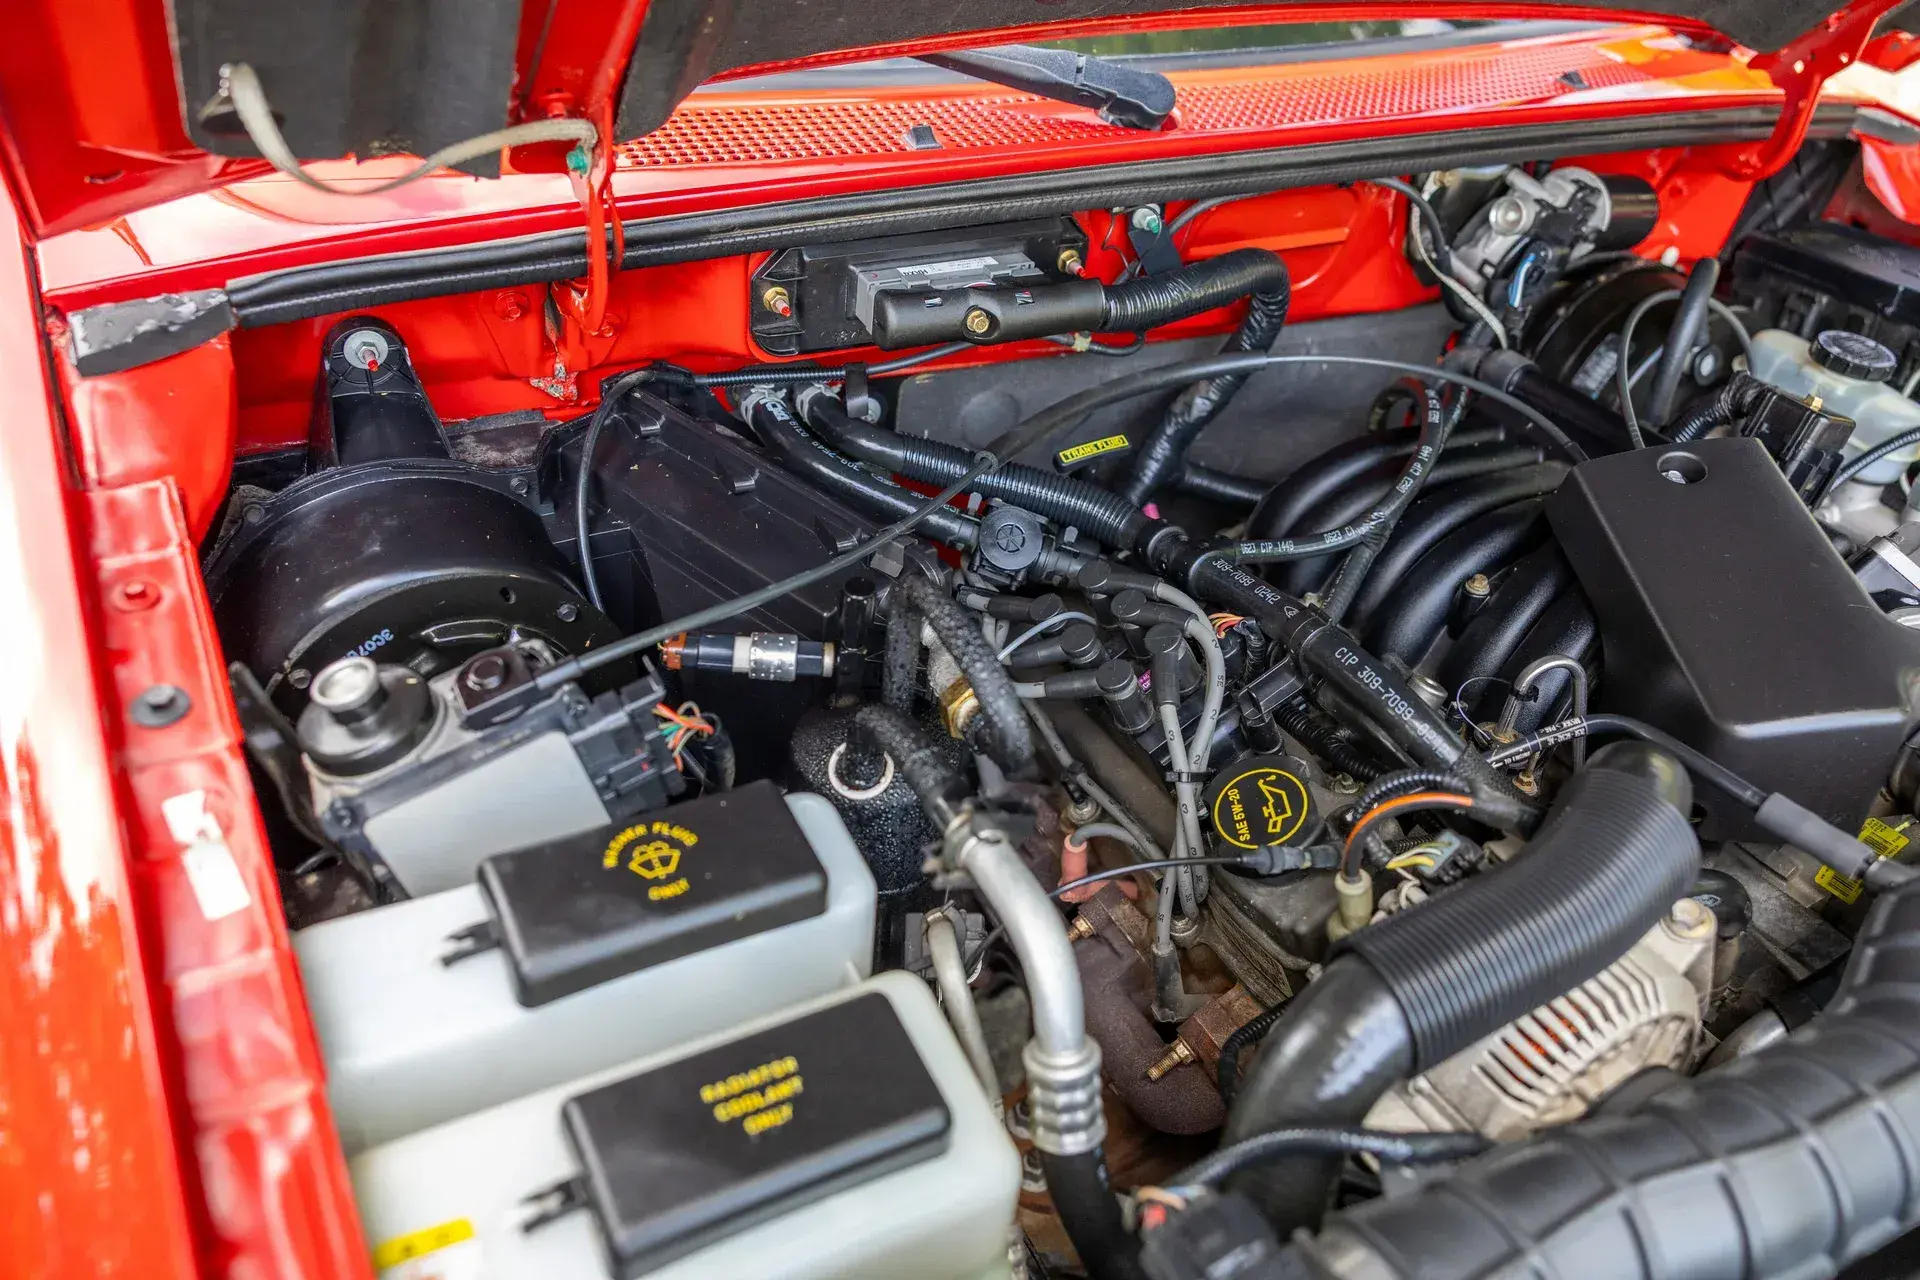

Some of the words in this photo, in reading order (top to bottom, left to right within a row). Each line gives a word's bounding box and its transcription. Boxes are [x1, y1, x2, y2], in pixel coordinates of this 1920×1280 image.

[1212, 558, 1255, 587] 309-7099
[1254, 586, 1281, 605] 0242
[1334, 647, 1359, 666] CIP
[1357, 665, 1415, 721] 309-7099
[1227, 788, 1246, 820] 5W-20
[652, 821, 698, 847] FLUID
[1236, 820, 1251, 841] SAE
[700, 1055, 799, 1104] RADIATOR
[713, 1075, 804, 1122] COOLANT
[743, 1102, 793, 1135] ONLY
